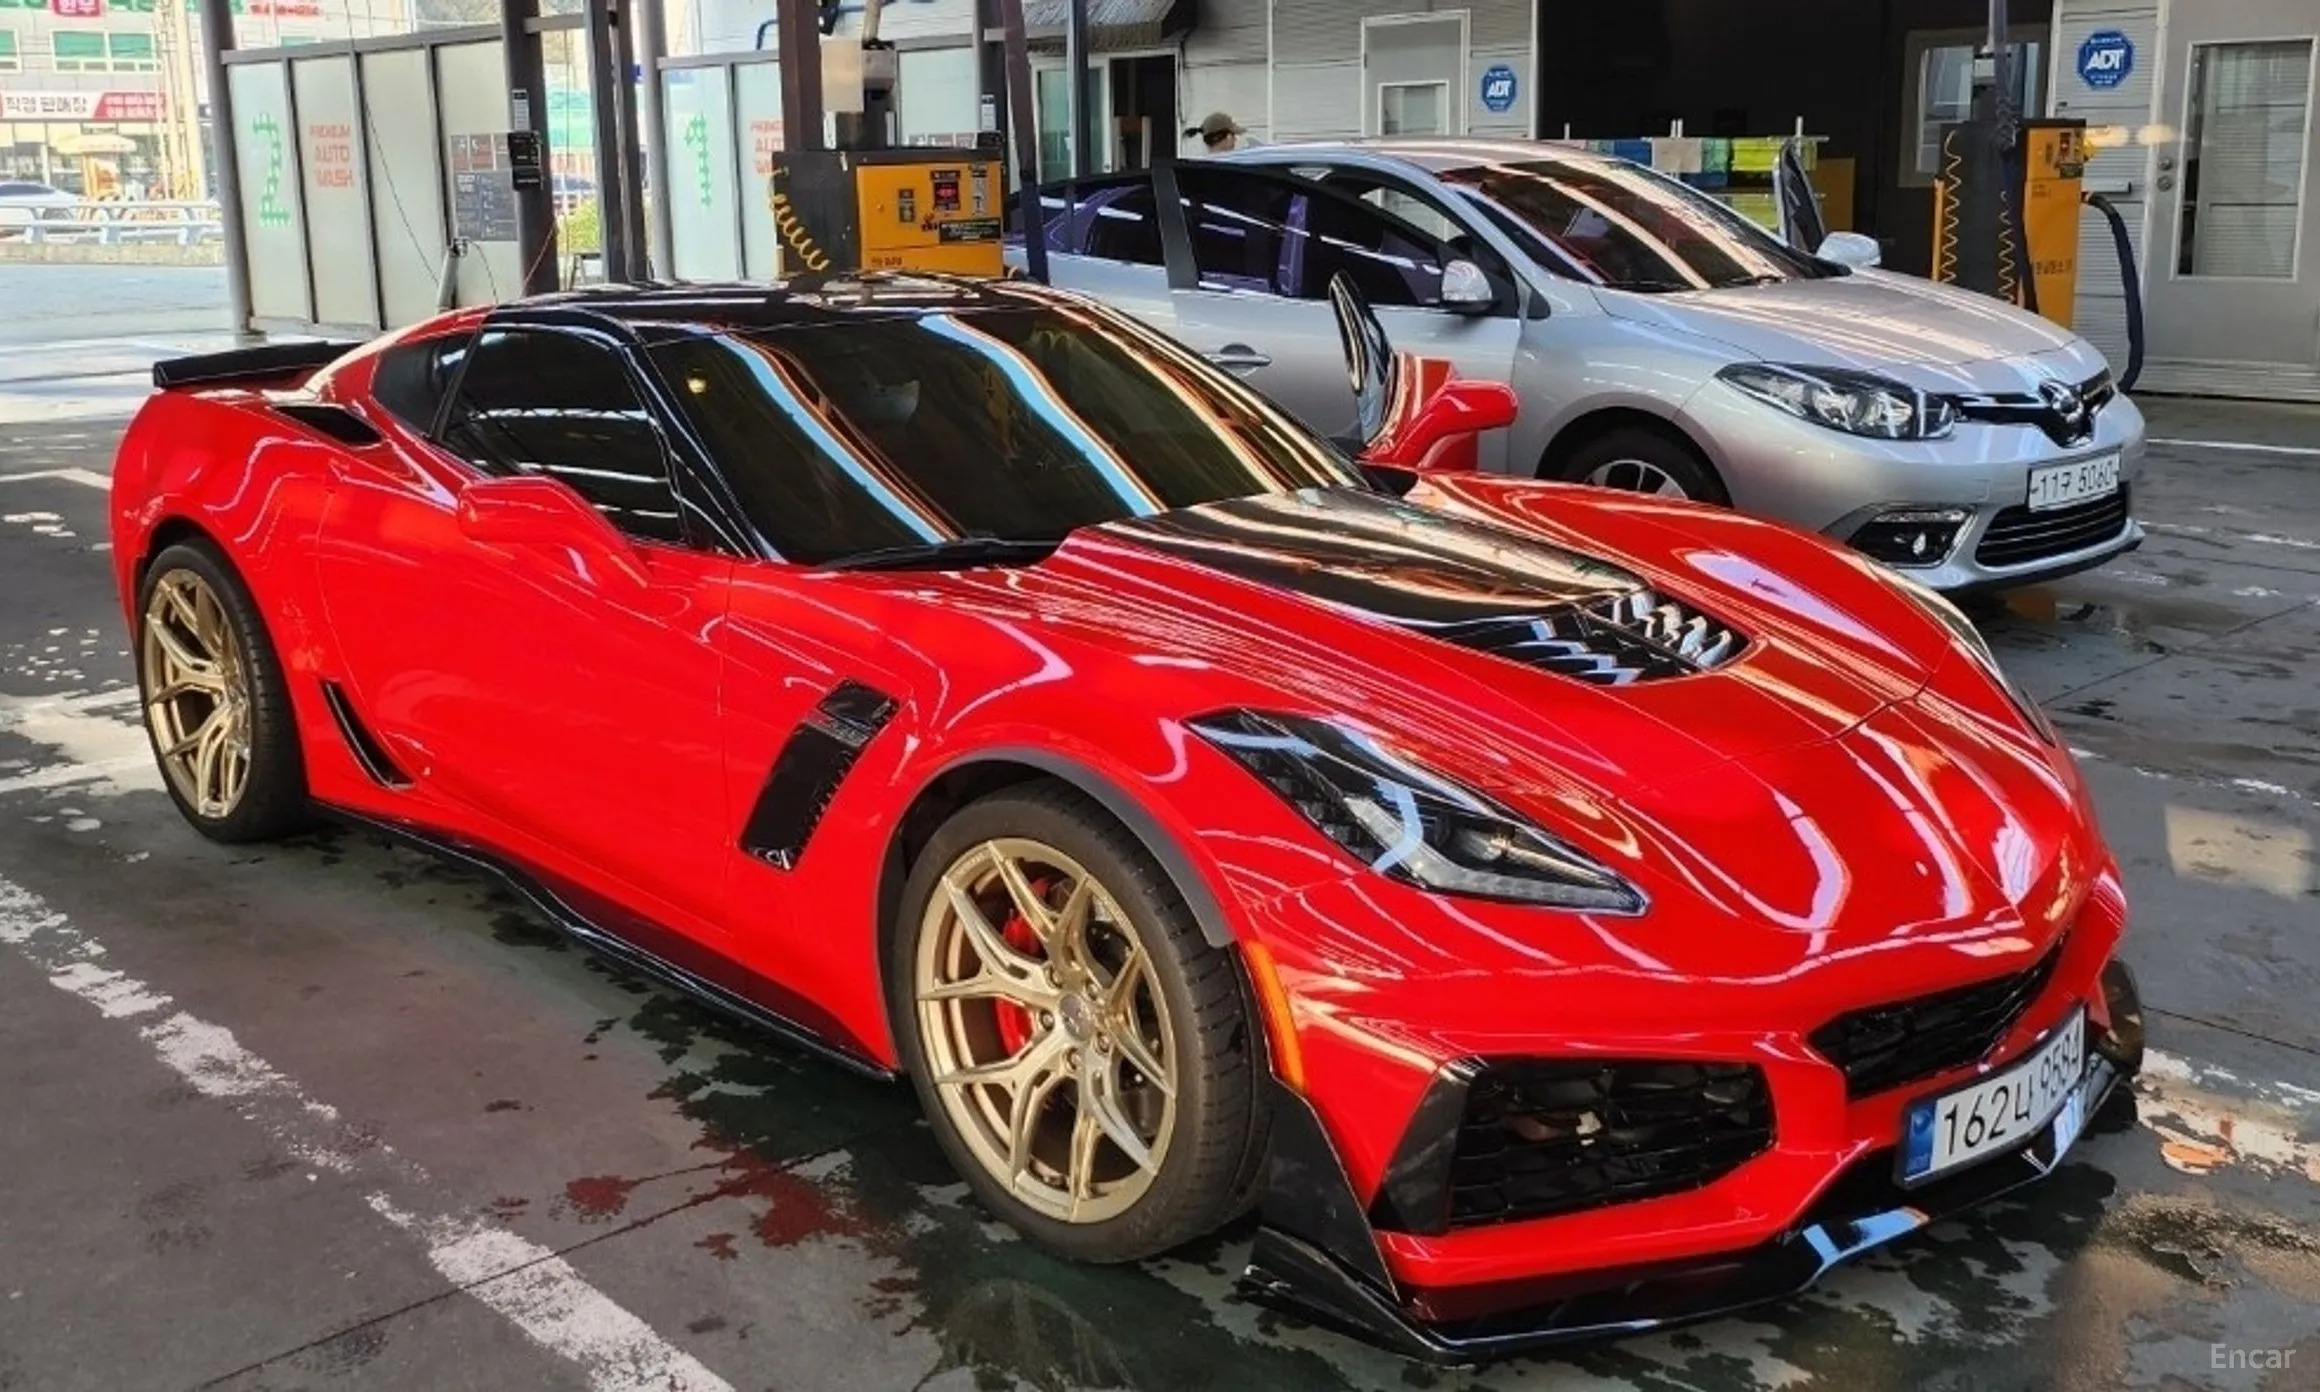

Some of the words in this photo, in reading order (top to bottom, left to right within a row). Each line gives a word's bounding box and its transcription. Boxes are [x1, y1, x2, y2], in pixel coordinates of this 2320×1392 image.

[2085, 49, 2125, 70] ADT
[1486, 80, 1511, 98] ADT
[315, 144, 350, 162] AUTO
